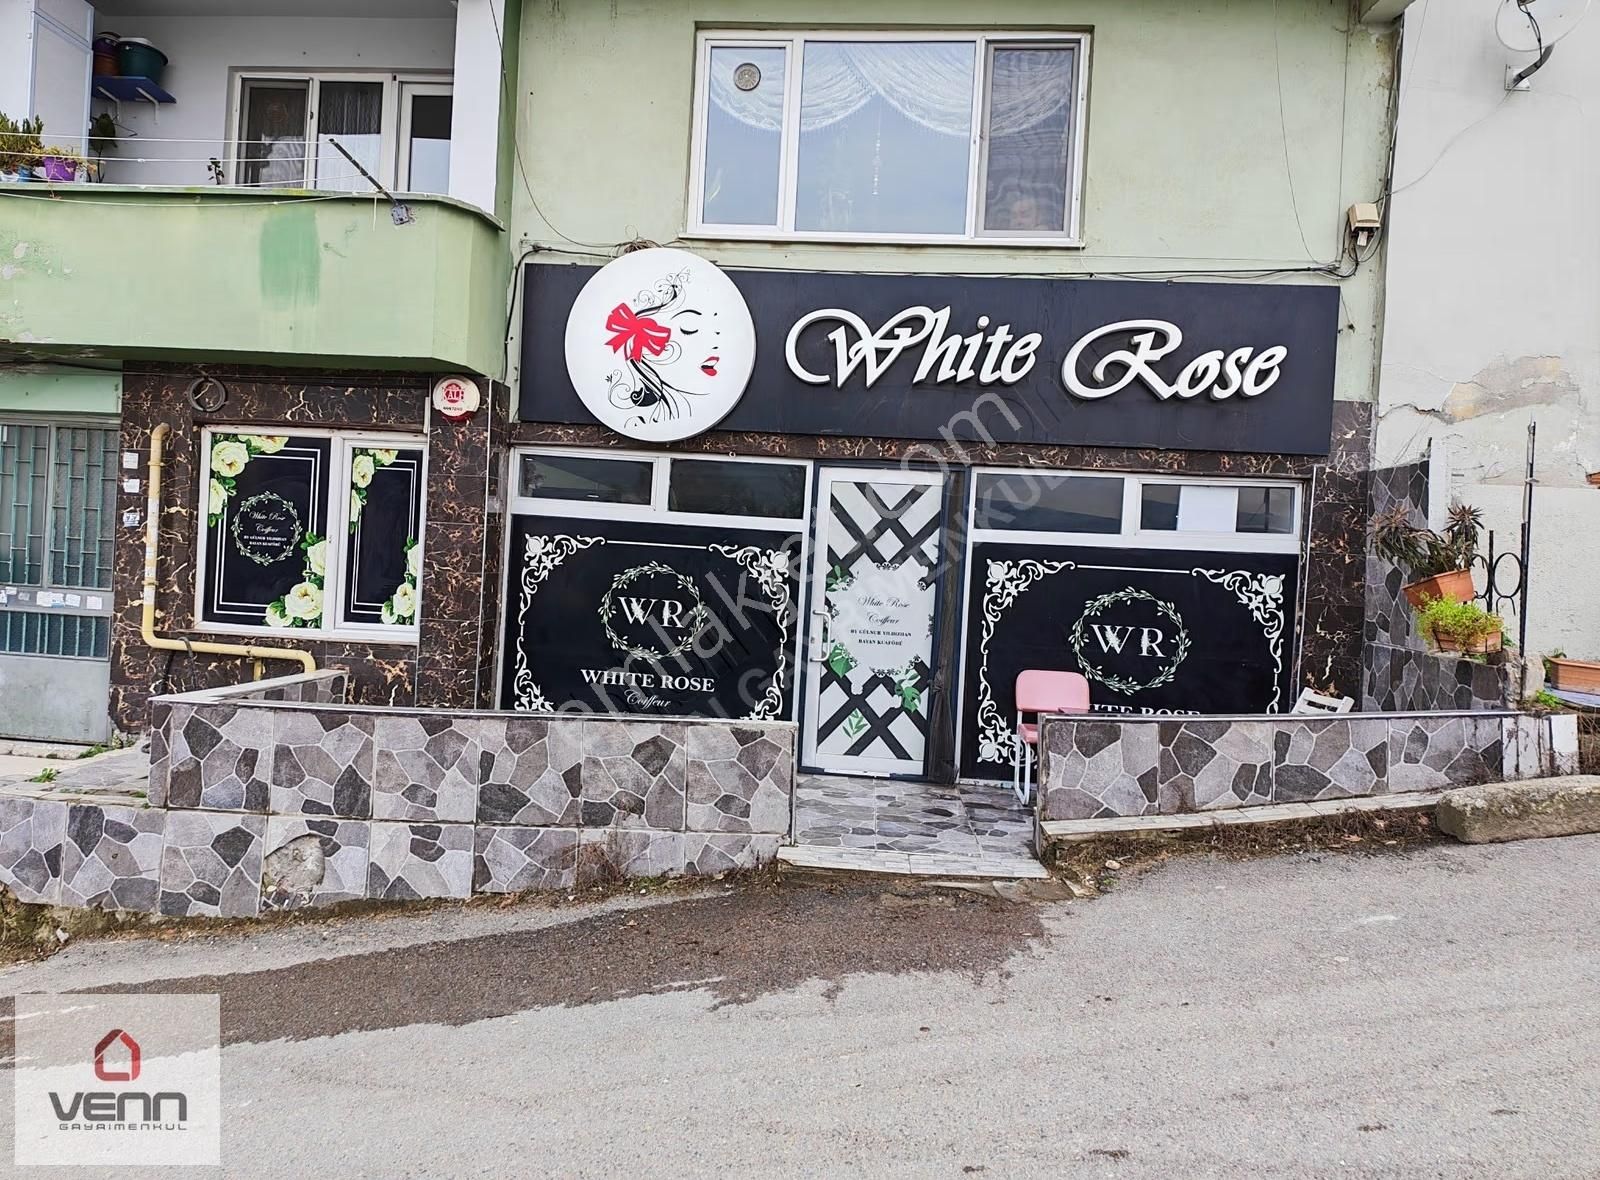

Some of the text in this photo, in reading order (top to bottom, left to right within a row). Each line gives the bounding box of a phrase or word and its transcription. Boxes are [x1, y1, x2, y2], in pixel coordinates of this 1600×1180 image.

[785, 305, 1289, 400] White Rose
[858, 595, 910, 609] White Rose
[867, 611, 900, 626] Coiffeur
[580, 669, 715, 692] WHITE ROSE
[624, 689, 671, 709] Coiffeur
